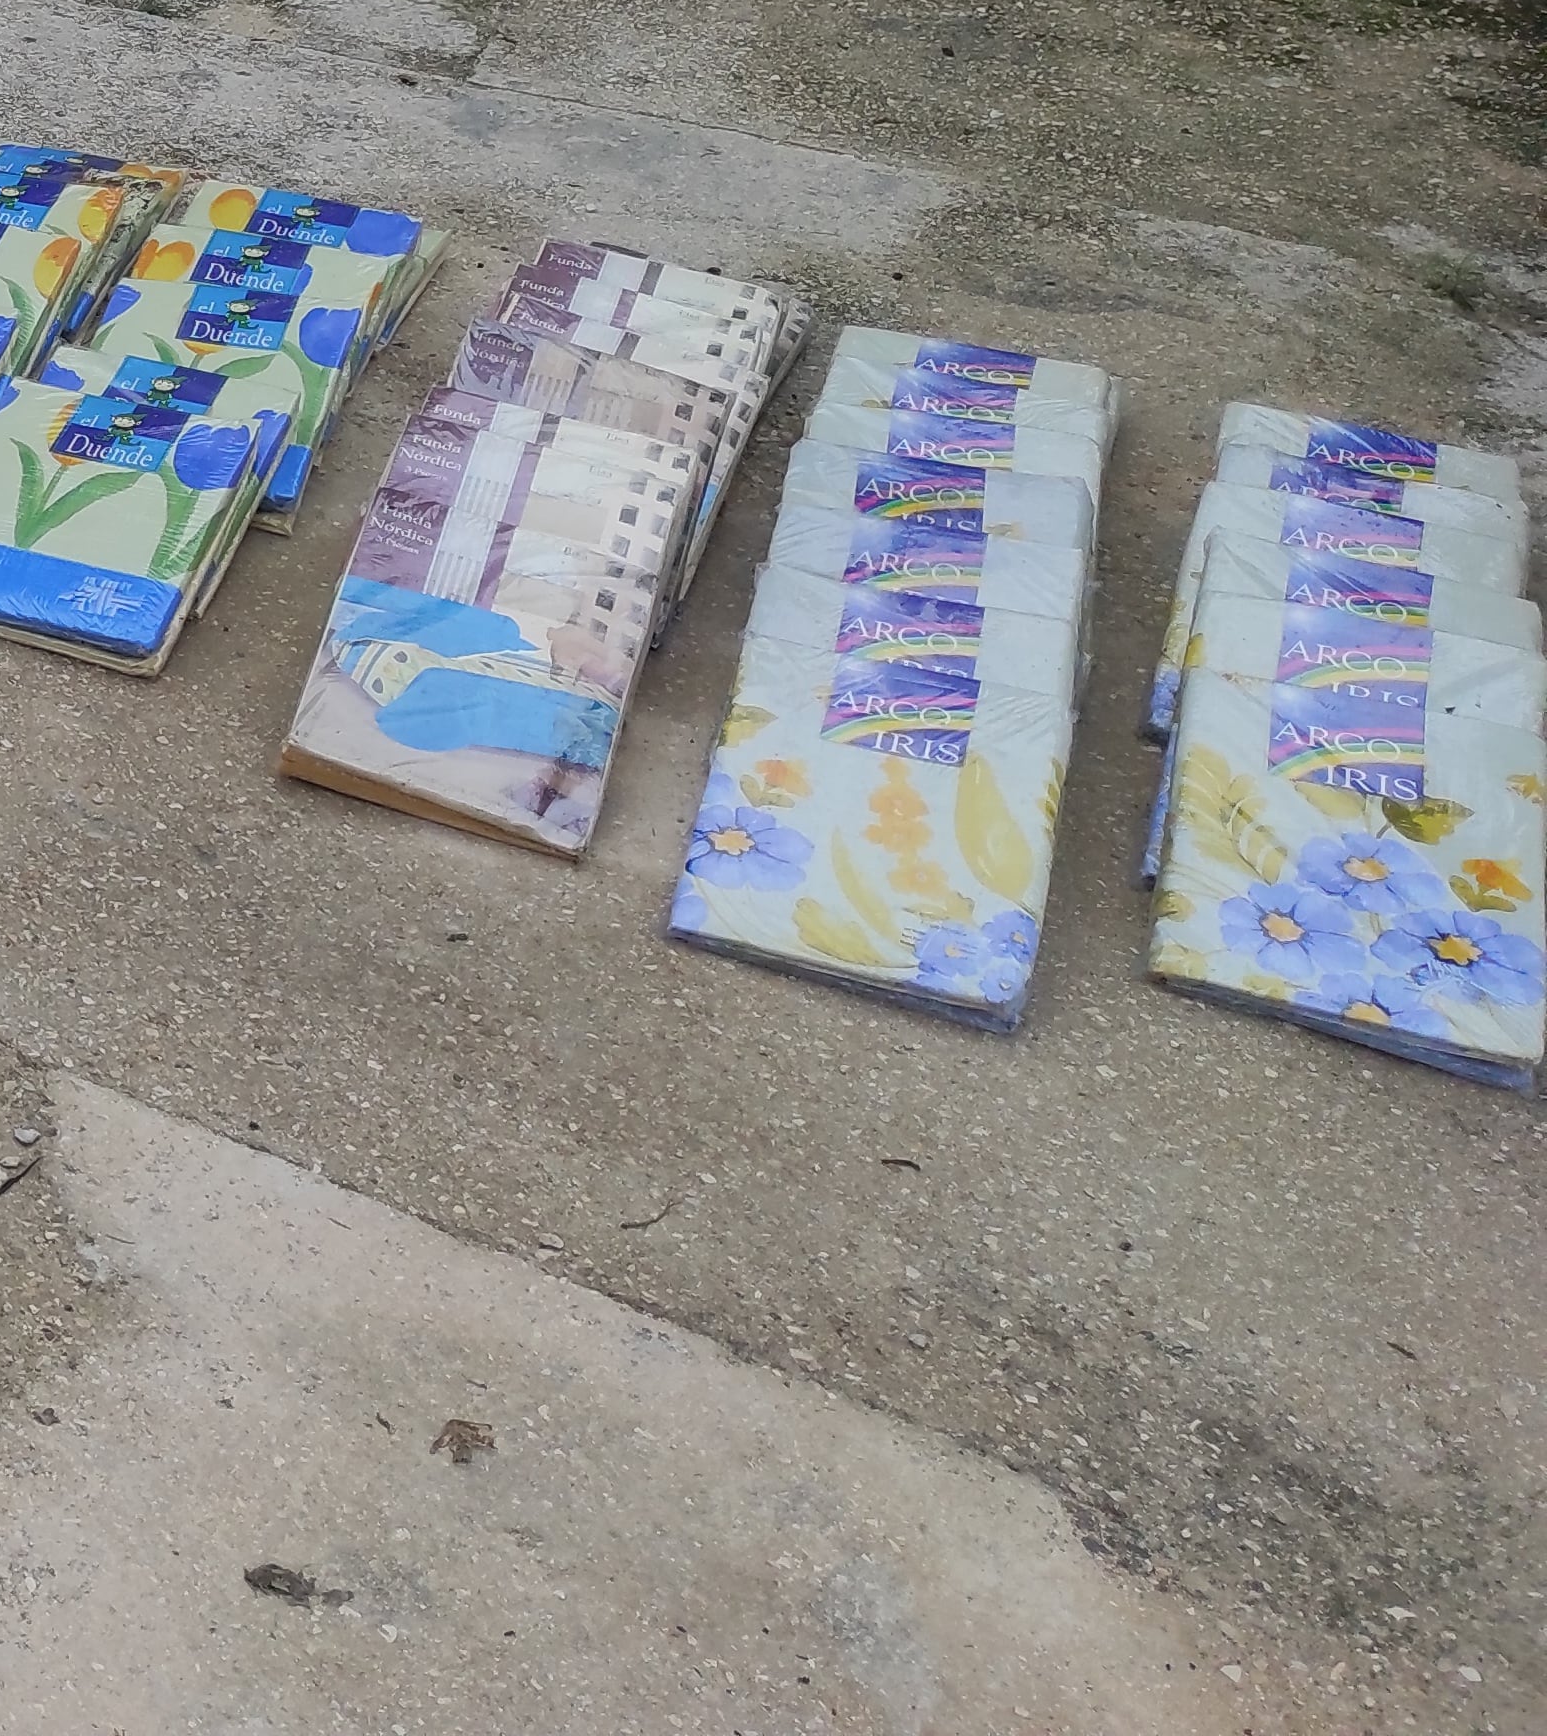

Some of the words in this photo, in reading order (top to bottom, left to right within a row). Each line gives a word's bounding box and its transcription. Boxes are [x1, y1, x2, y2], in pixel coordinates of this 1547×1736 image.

[266, 204, 283, 214] el
[258, 218, 336, 245] Duende
[213, 246, 230, 257] el
[548, 253, 592, 270] Funda
[204, 262, 284, 292] Duende
[519, 279, 565, 297] Funda
[198, 302, 214, 314] el
[190, 319, 273, 347] Duende
[519, 311, 566, 334] Funda
[120, 377, 141, 391] el
[916, 358, 1015, 383] ARCO
[80, 415, 99, 427] el
[433, 404, 482, 425] Funda
[65, 433, 153, 467] Duende
[413, 434, 462, 454] Funda
[890, 438, 995, 465] ARCO
[398, 446, 463, 472] Nórdica
[1308, 443, 1415, 479] ARCO
[857, 477, 966, 508] ARCO
[382, 504, 432, 529] Funda
[370, 516, 434, 546] Nórdica
[1282, 527, 1399, 560] ARCO
[851, 551, 961, 584] ARCO
[1287, 583, 1407, 622] ARCO
[843, 616, 958, 653] ARCO
[1283, 639, 1406, 679] ARCO
[832, 689, 951, 729] ARCO
[872, 731, 960, 764] IRIS
[1273, 722, 1401, 761] ARCO
[1324, 765, 1418, 801] IRIS
